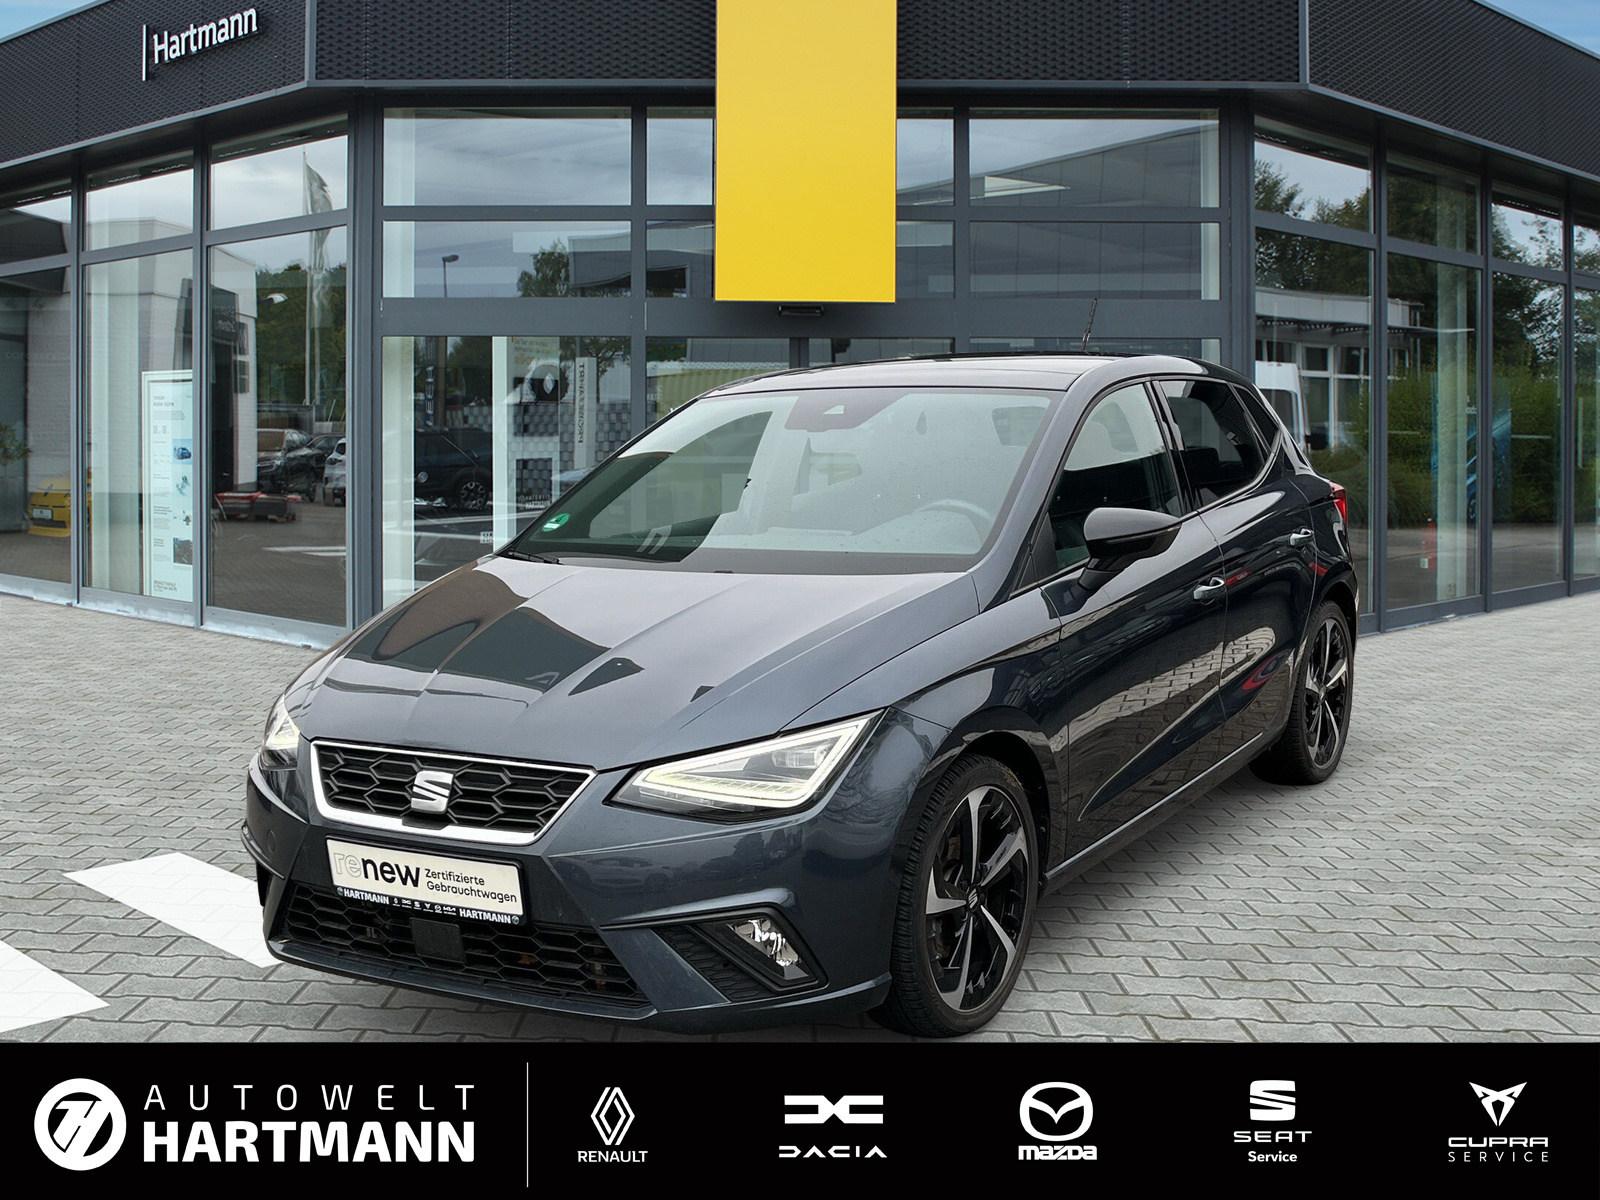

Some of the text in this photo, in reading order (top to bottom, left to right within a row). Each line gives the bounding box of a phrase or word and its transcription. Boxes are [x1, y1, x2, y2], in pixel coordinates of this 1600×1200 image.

[153, 8, 257, 64] Hartmann
[333, 852, 421, 887] renew
[424, 868, 485, 885] Zertifizierte
[343, 888, 389, 905] HARTMANN
[459, 908, 511, 924] HARTMANN
[426, 880, 517, 903] Gebrauchtwagen
